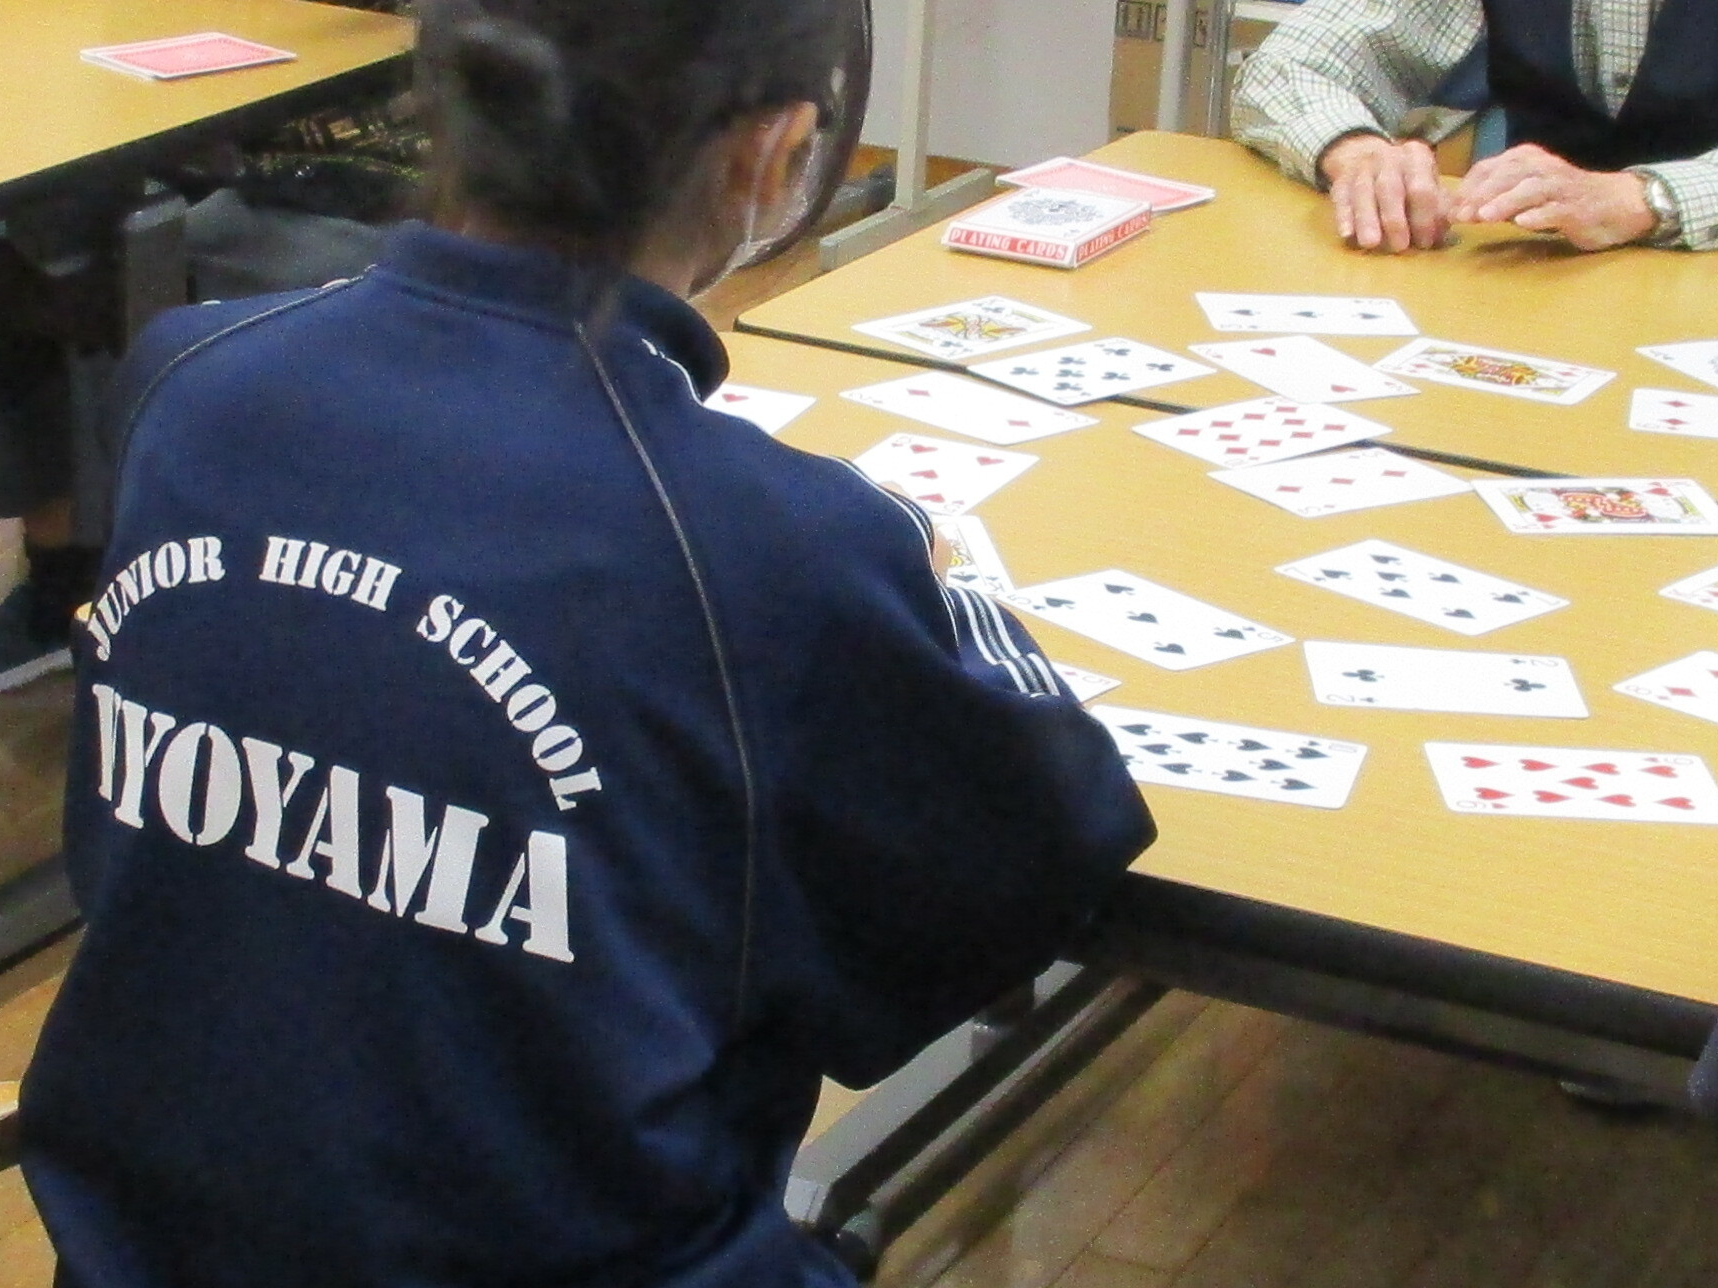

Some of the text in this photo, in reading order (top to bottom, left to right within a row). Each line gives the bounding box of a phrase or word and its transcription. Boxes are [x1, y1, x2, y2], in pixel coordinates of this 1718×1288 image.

[950, 230, 1066, 261] PLAYING CARDS
[87, 536, 602, 811] JUNIOR HIGH SCHOOL
